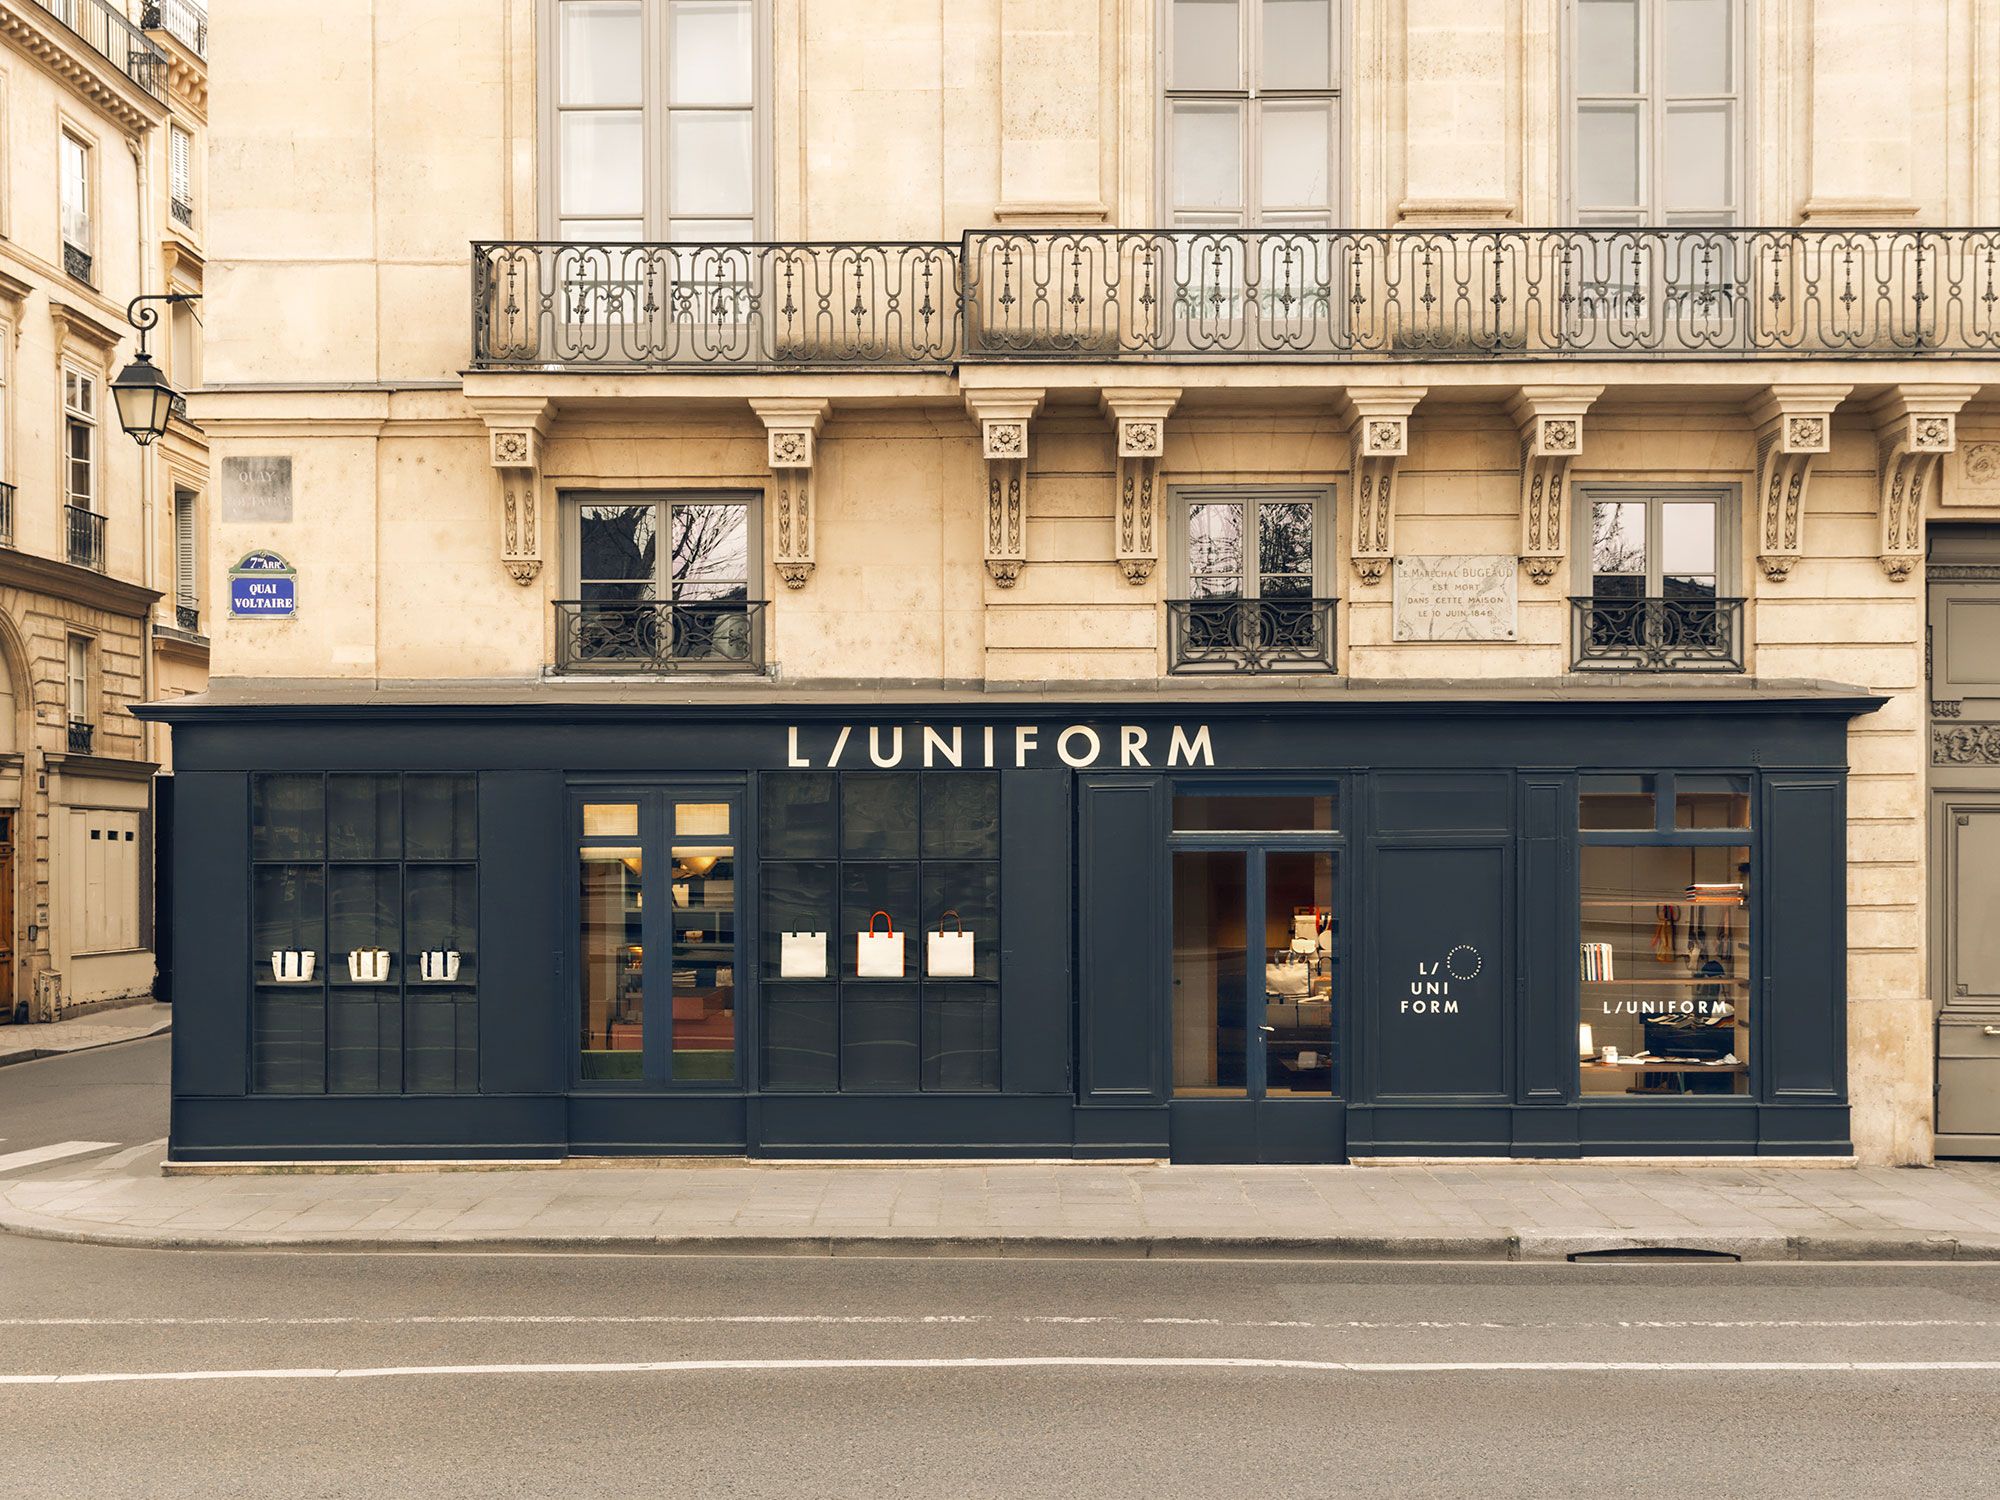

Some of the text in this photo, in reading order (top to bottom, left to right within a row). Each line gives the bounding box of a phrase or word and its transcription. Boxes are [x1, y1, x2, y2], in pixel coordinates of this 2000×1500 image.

[239, 471, 275, 484] QUAY
[1462, 568, 1513, 578] BUGEAUD
[249, 583, 277, 595] QUAI
[234, 598, 292, 608] VOLTAIRE
[788, 725, 1215, 768] L/UNIFORM
[1411, 982, 1448, 995] UNI
[1400, 1000, 1459, 1014] FORM
[1603, 1000, 1727, 1014] L/UNIFORM
